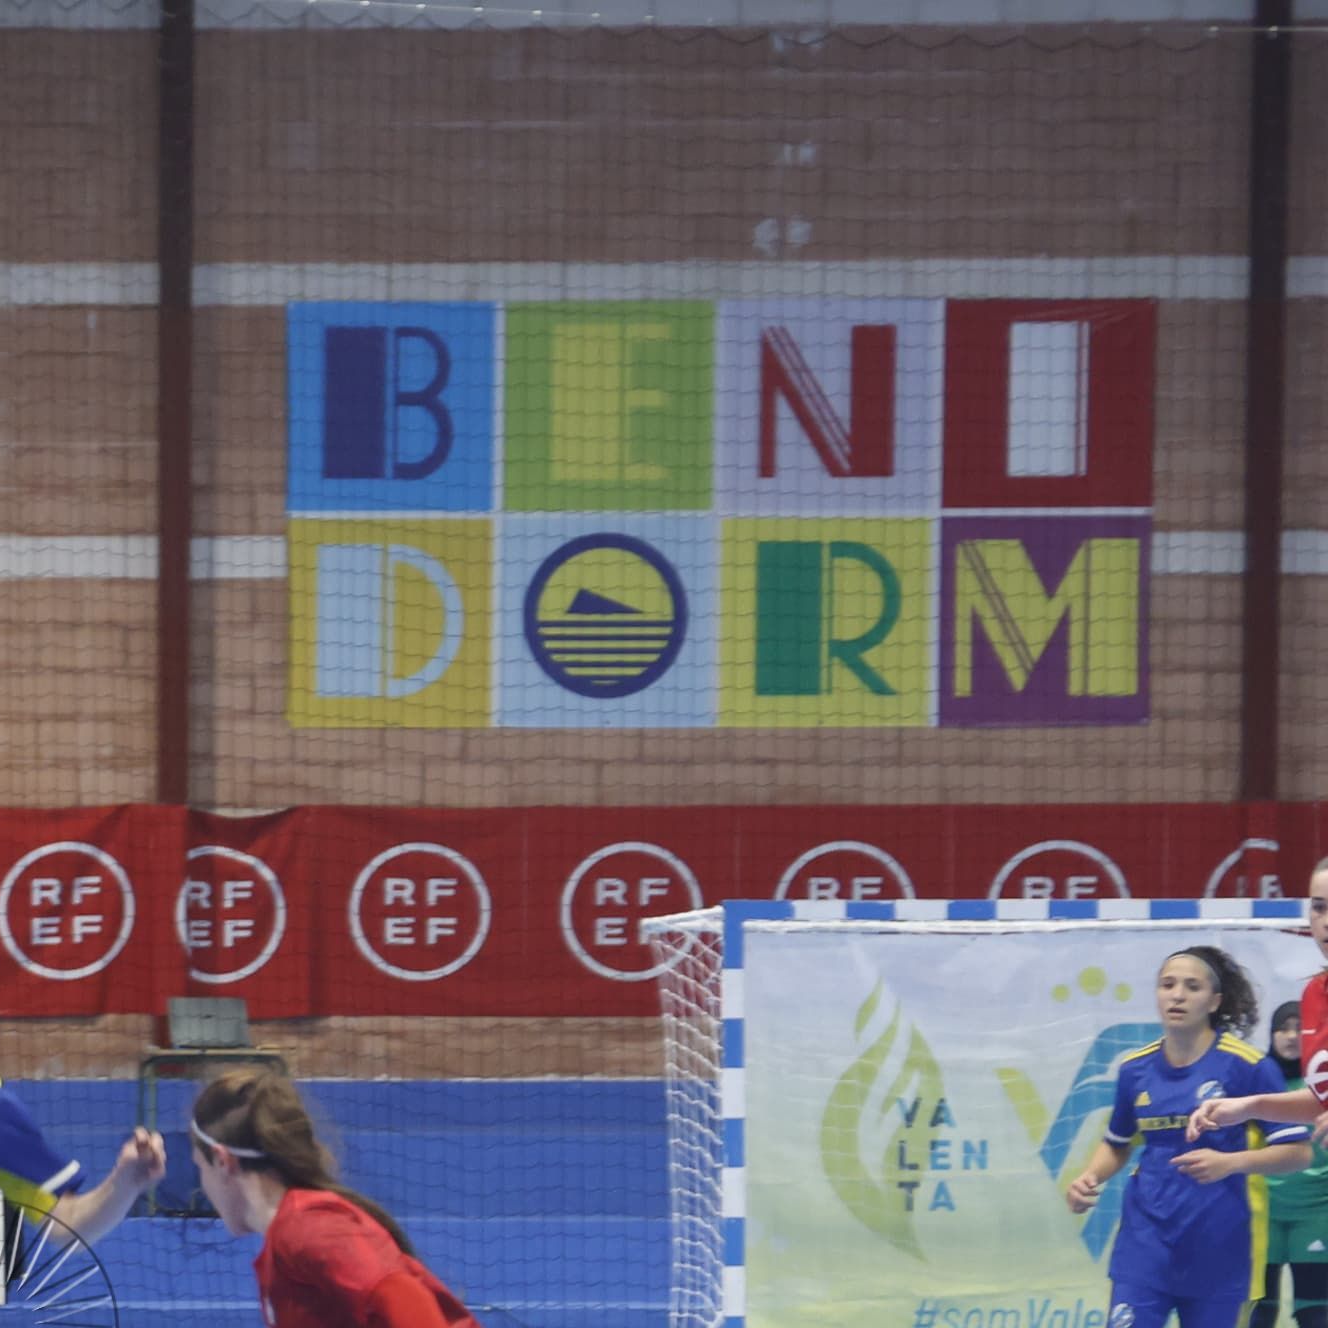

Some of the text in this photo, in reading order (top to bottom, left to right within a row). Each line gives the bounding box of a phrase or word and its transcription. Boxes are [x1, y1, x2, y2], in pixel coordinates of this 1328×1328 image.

[322, 320, 1090, 480] BENI
[314, 532, 1142, 699] DORM
[31, 875, 102, 906] RF
[187, 880, 255, 909] RF
[384, 877, 457, 906] RF
[596, 878, 670, 906] RF
[807, 876, 884, 900] RF
[1021, 876, 1098, 900] RF
[31, 915, 103, 946] EF
[189, 919, 255, 948] EF
[384, 917, 457, 945] EF
[896, 1097, 957, 1128] VA
[898, 1139, 988, 1171] LEN
[896, 1180, 957, 1212] TA
